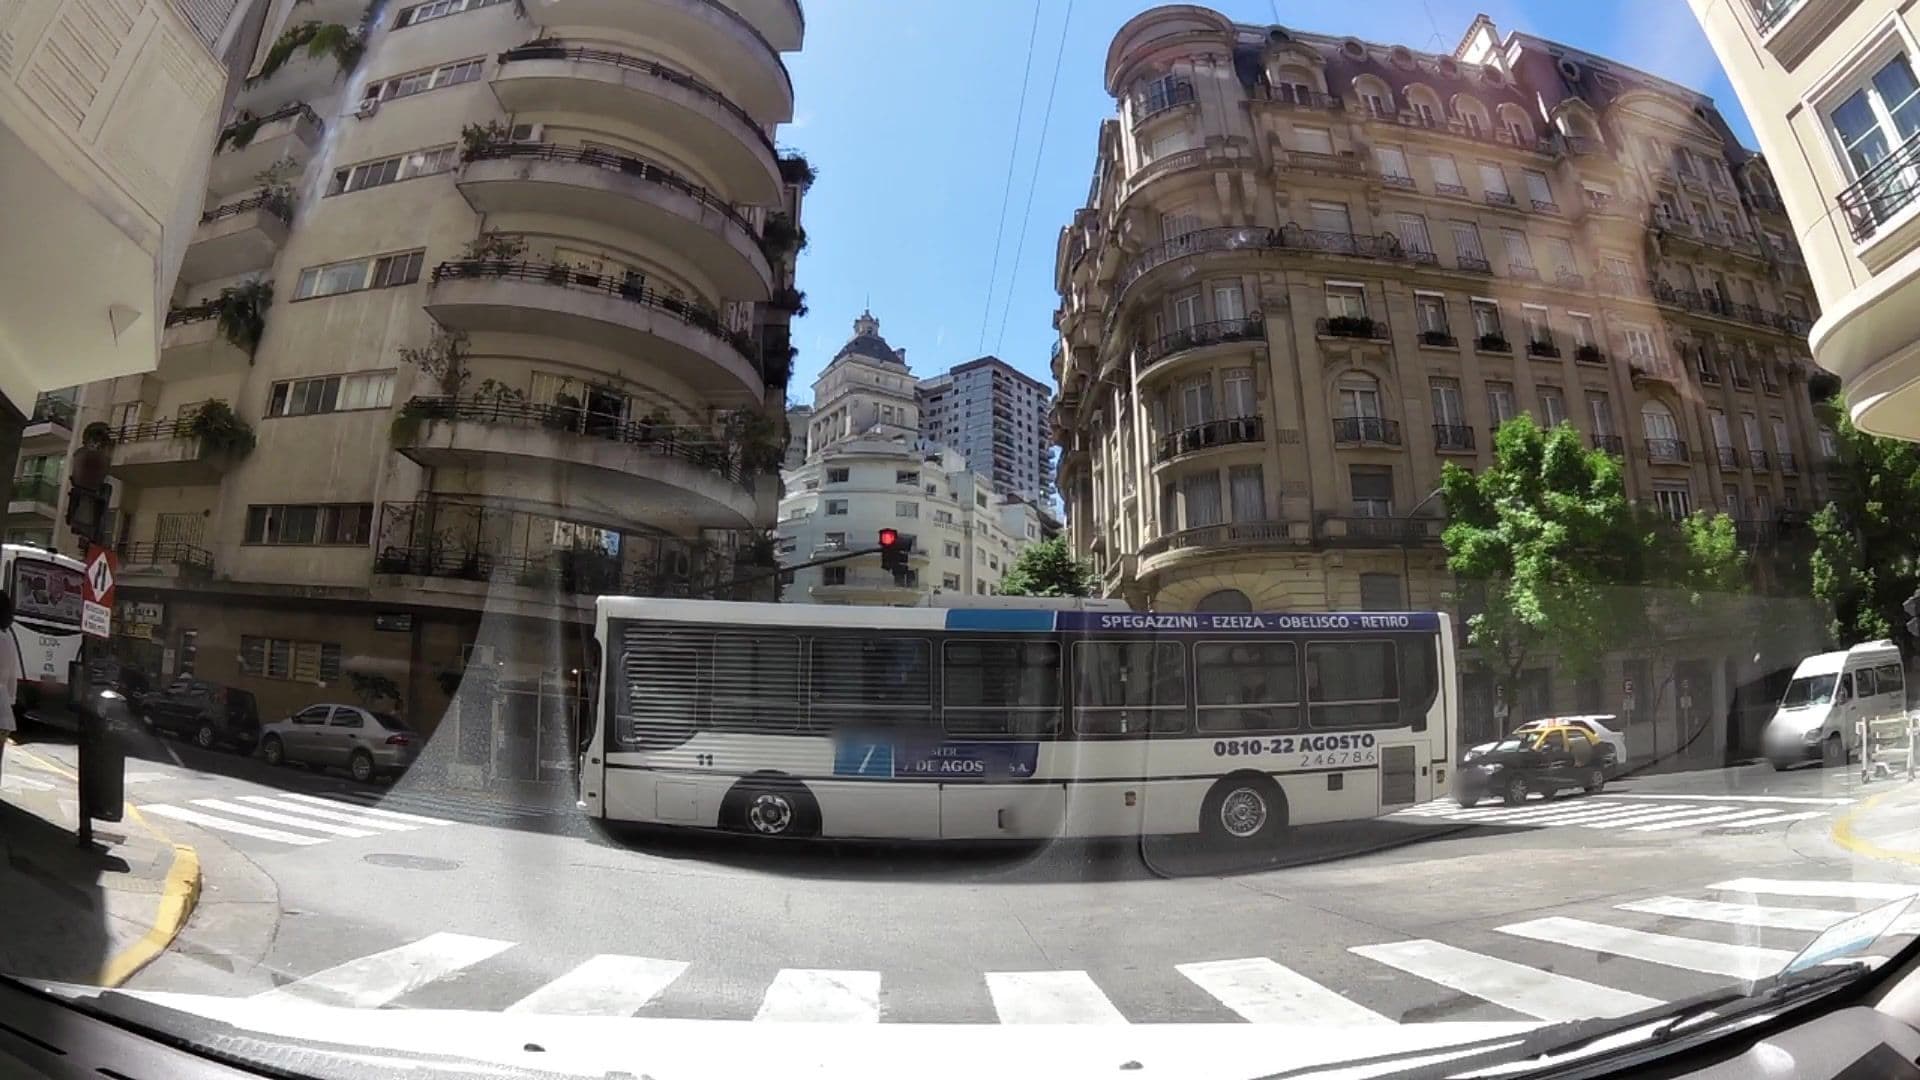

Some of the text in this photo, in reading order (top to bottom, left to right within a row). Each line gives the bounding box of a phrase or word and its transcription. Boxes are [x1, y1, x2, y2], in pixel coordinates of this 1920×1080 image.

[1101, 615, 1199, 629] SPEGAZZINI
[1212, 615, 1265, 629] EZEIZA
[1279, 615, 1349, 629] OBELISCO
[1361, 615, 1410, 628] RETIRO
[1214, 733, 1376, 756] 0810-22 AGOSTO
[940, 759, 990, 773] AGOS
[1301, 751, 1376, 767] 246786
